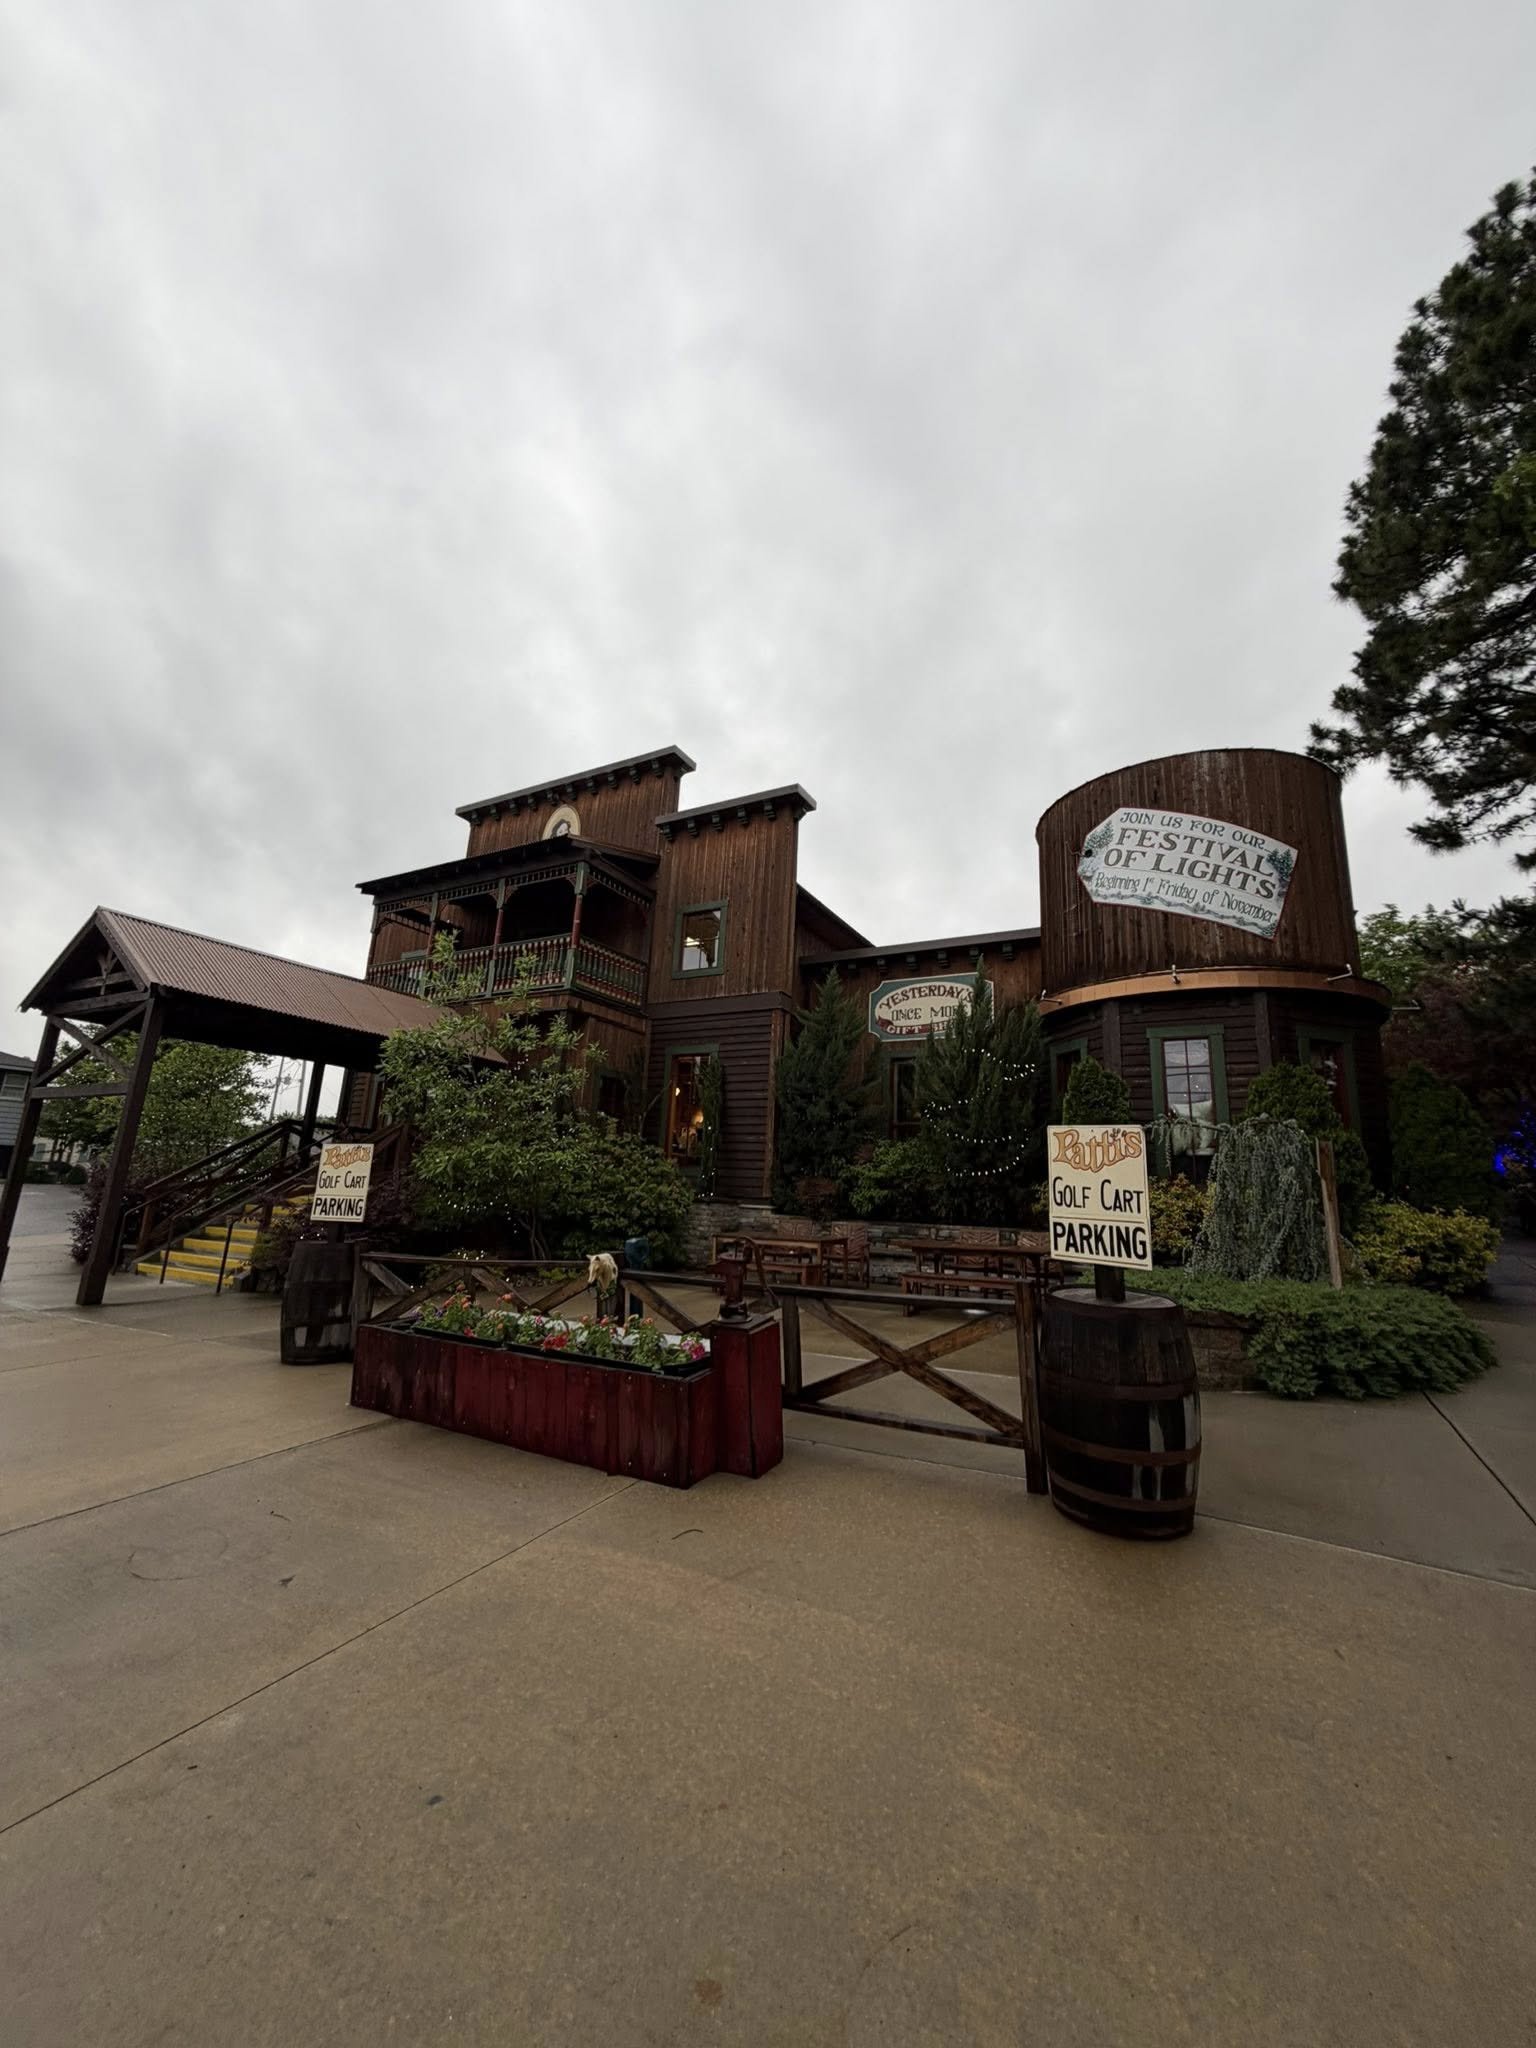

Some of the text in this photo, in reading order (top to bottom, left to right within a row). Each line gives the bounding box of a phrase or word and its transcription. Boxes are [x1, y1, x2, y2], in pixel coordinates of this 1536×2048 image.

[1120, 812, 1155, 825] JOIN
[1161, 815, 1183, 829] US
[1189, 819, 1225, 837] FOR
[1115, 827, 1275, 877] FESTIVAL
[1103, 848, 1276, 899] OF LIGHTS
[1095, 872, 1140, 893] Beginning
[1157, 878, 1197, 904] Friday
[1202, 889, 1219, 905] of
[1220, 891, 1277, 922] November
[879, 985, 974, 1010] YESTERDAY'S
[891, 1007, 922, 1021] ONCE
[886, 1026, 922, 1035] GIFT
[1053, 1128, 1142, 1173] Patti's
[313, 1197, 364, 1217] PARKING
[1053, 1221, 1148, 1260] PARKING
